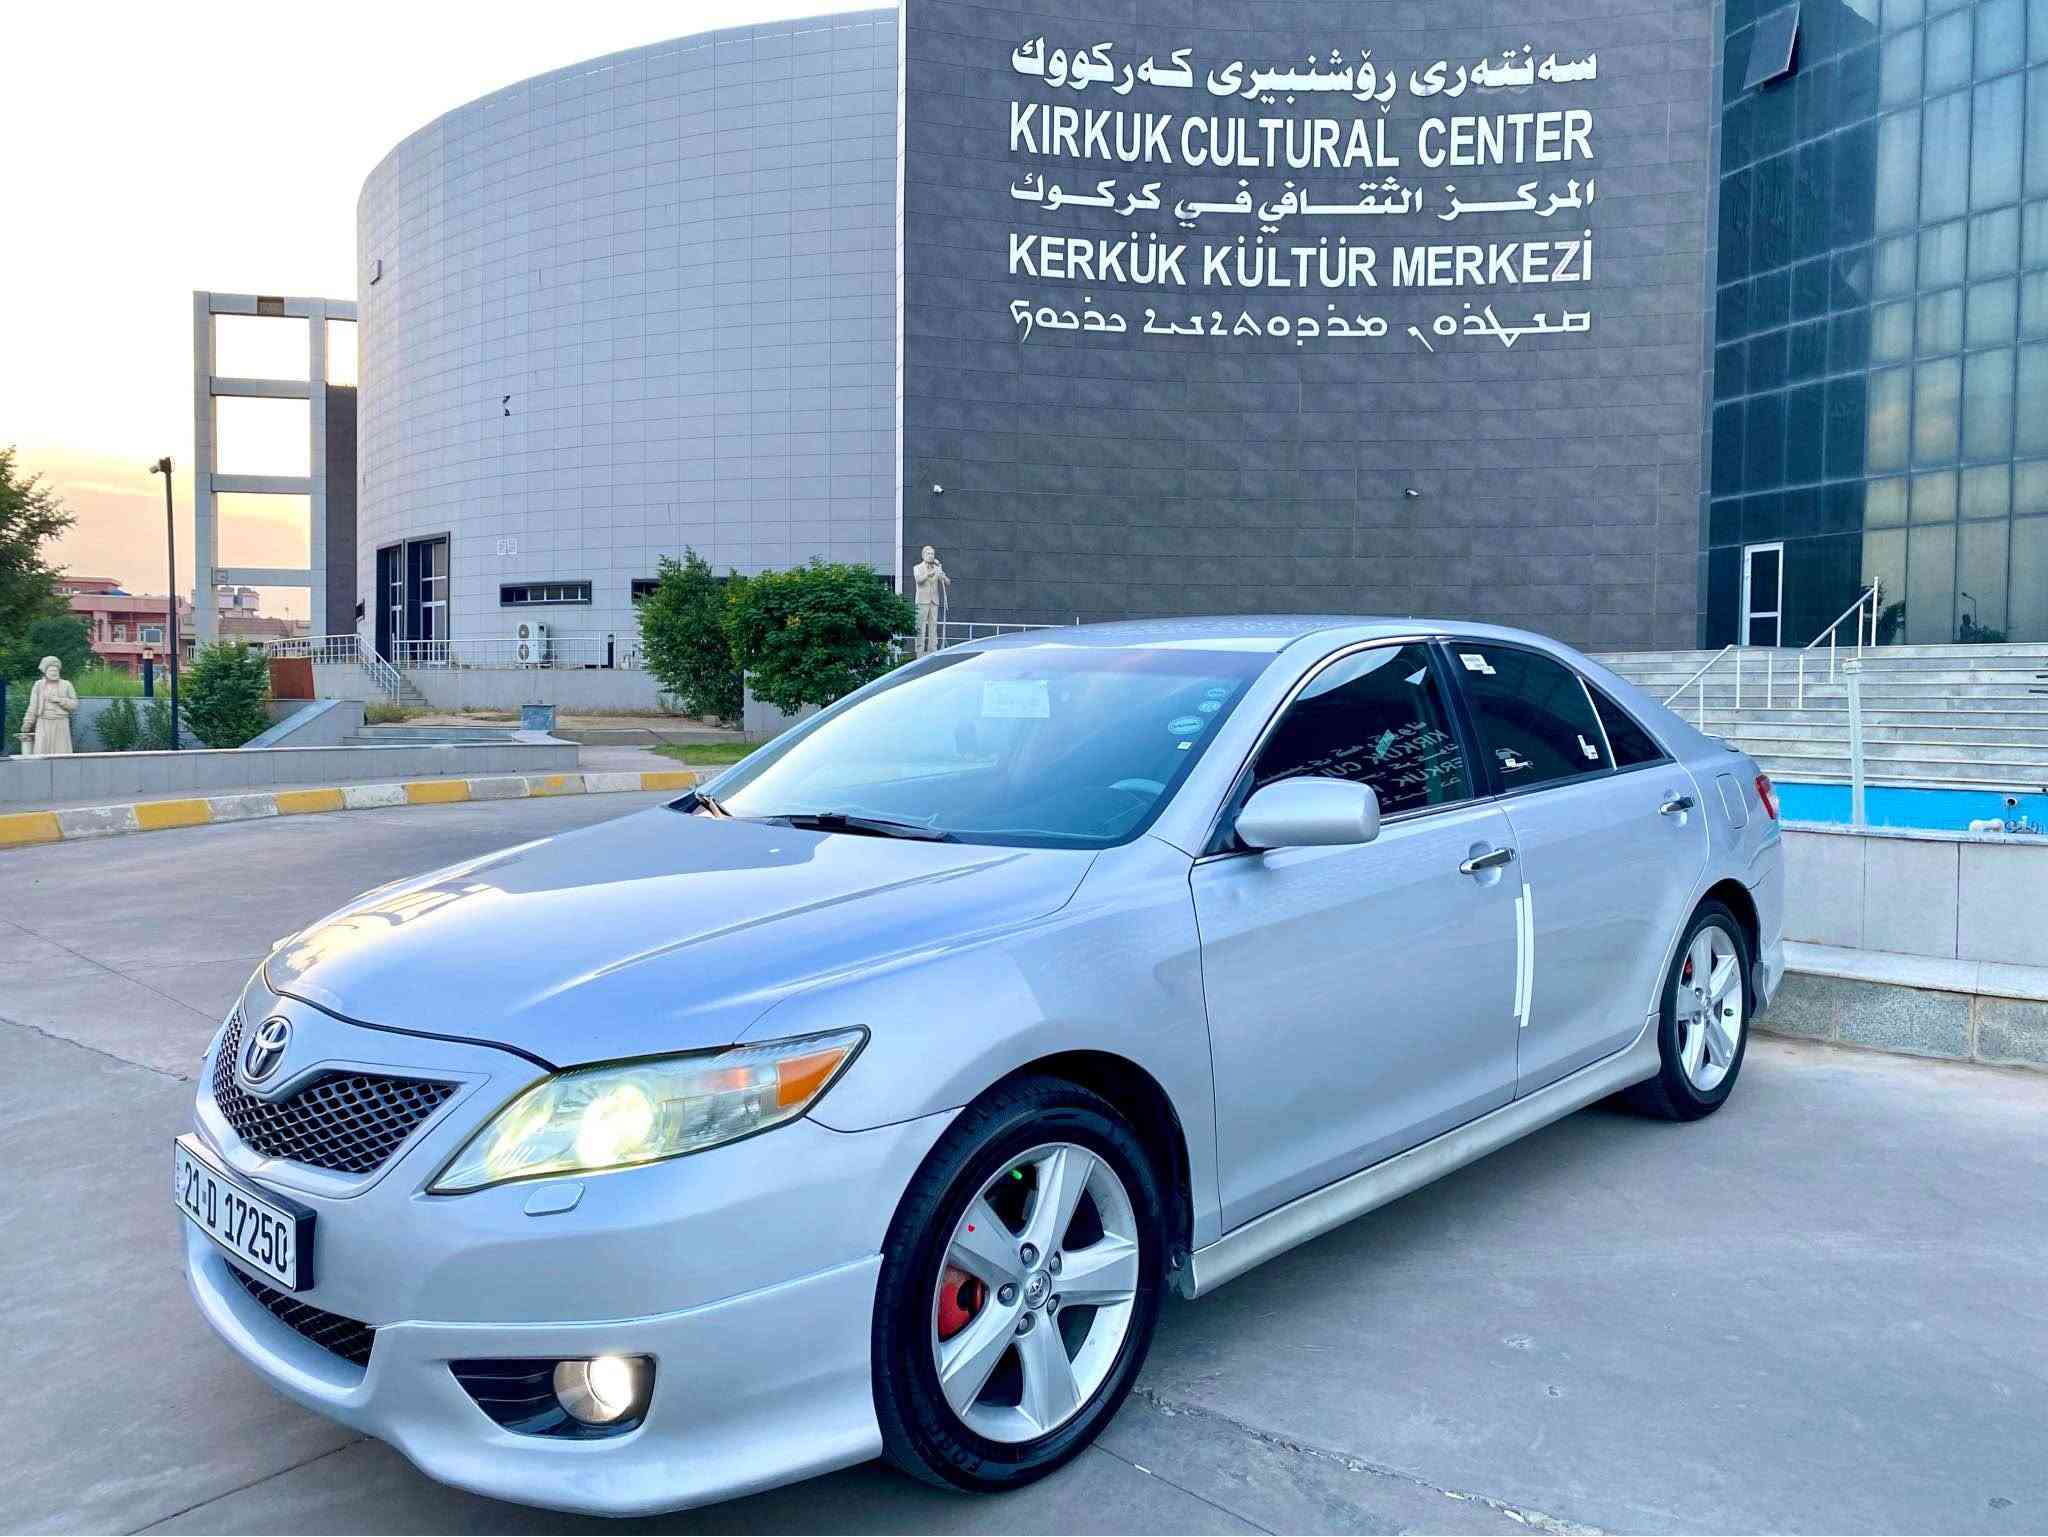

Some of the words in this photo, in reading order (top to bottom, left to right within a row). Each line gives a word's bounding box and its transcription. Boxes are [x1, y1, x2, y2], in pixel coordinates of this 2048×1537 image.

[1010, 101, 1173, 164] KIRKUK
[1181, 116, 1400, 169] CULTURAL
[1418, 109, 1594, 168] CENTER
[1010, 172, 1161, 217] كركوك
[1174, 178, 1253, 229] في
[1257, 176, 1423, 234] الثقافي
[1437, 178, 1595, 221] المركز
[1009, 231, 1187, 286] KERKÜK
[1203, 235, 1378, 288] KÜLTÜR
[1392, 228, 1592, 287] MERKEZİ
[185, 1161, 200, 1217] 21
[207, 1178, 217, 1229] D
[225, 1192, 288, 1274] 17250
